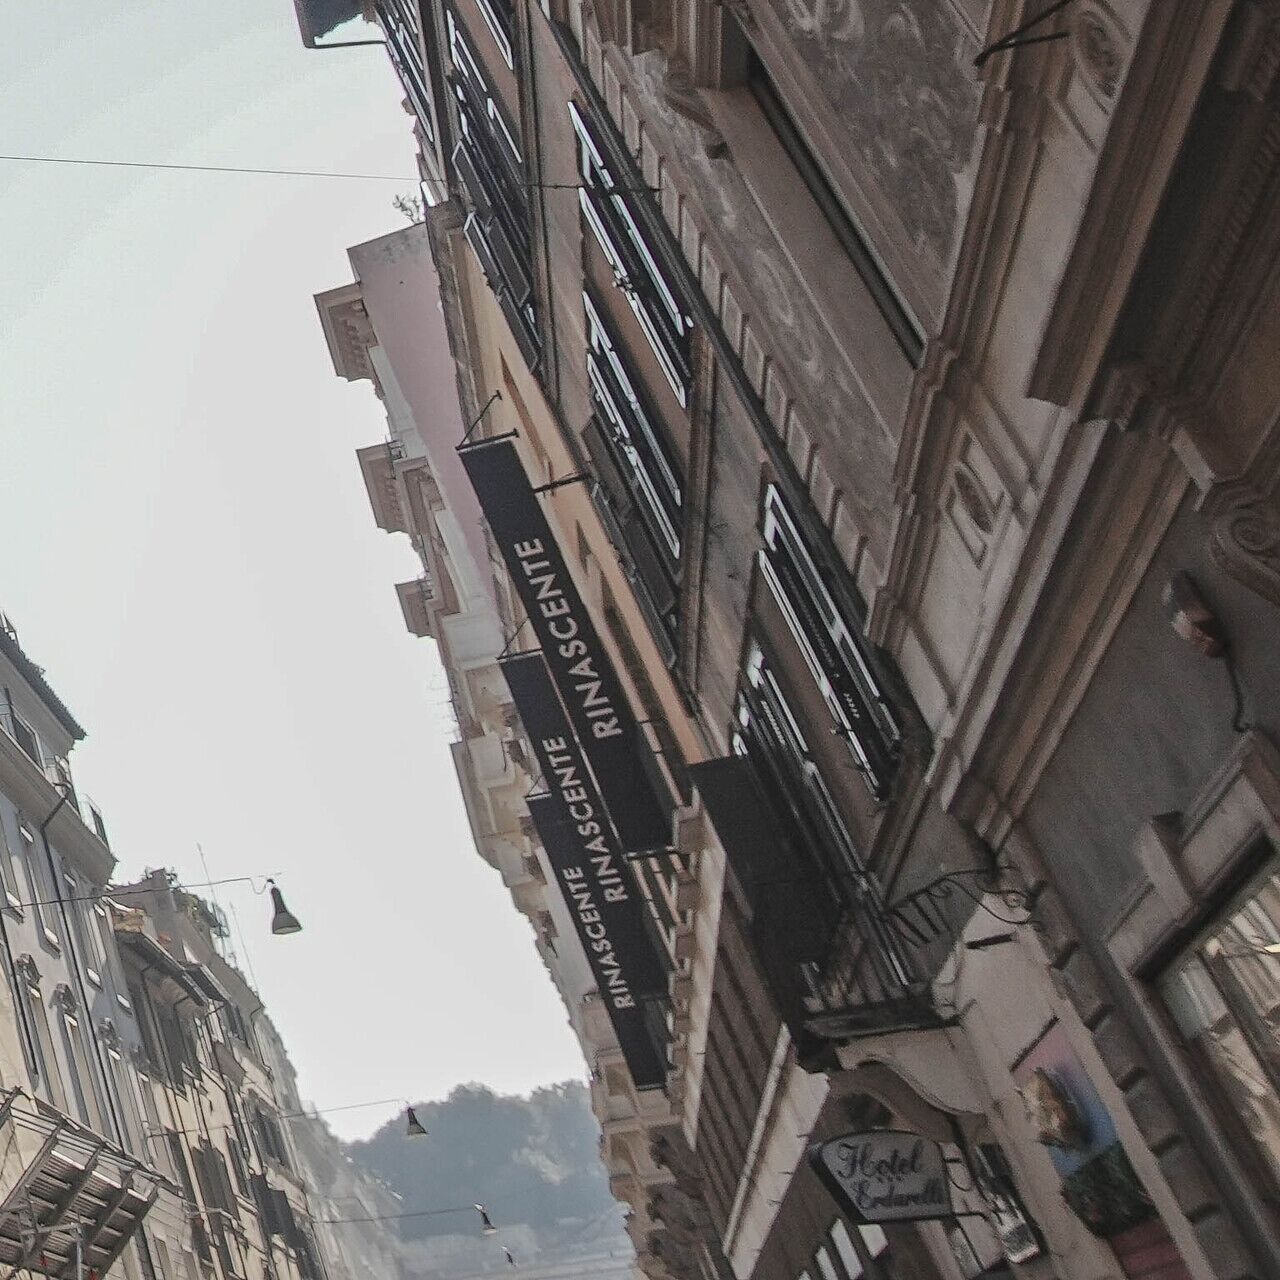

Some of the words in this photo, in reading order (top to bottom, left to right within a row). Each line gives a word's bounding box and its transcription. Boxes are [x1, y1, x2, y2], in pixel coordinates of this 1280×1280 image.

[513, 537, 624, 740] RINASCENTE
[541, 735, 629, 904] RINASCENTE
[562, 865, 637, 1010] RINASCENTE
[836, 1139, 925, 1179] Hotel
